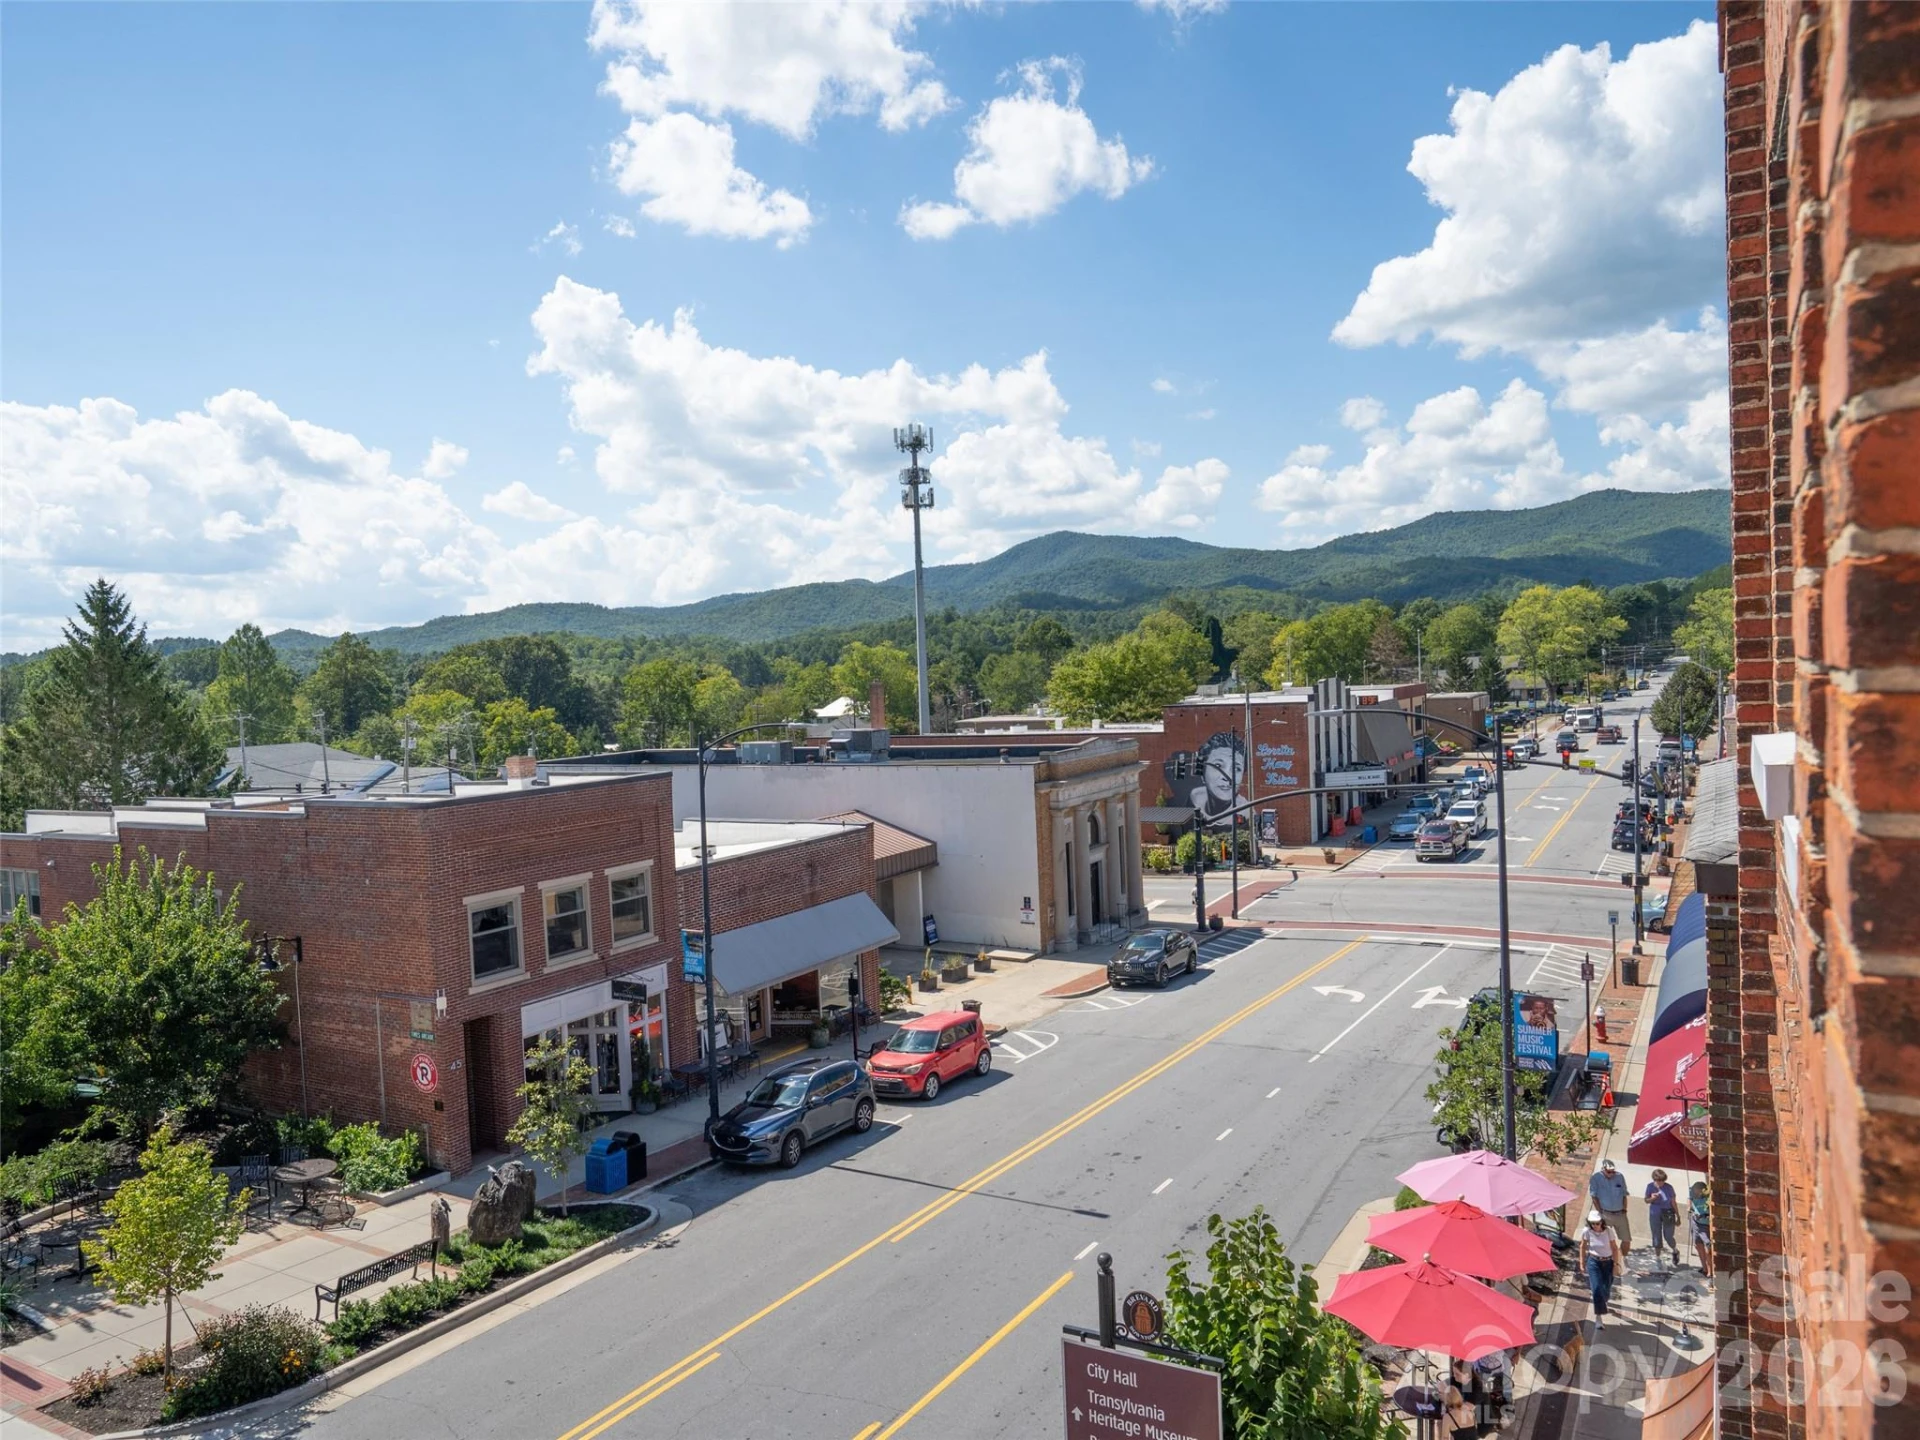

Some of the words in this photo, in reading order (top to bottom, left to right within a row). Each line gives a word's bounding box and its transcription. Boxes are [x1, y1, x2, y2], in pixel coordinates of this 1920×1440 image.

[1518, 1024, 1552, 1036] SUMMER
[1518, 1034, 1544, 1045] MUSIC
[1518, 1044, 1552, 1056] FESTIVAL
[419, 1056, 434, 1071] PUBLIC
[450, 1060, 462, 1070] 45
[1126, 1294, 1159, 1312] BREVARD
[1129, 1326, 1158, 1340] DOWNTOWN
[1086, 1363, 1110, 1384] City
[1113, 1370, 1138, 1388] Hall
[1087, 1389, 1165, 1422] Transylvania
[1088, 1409, 1141, 1437] Heritage
